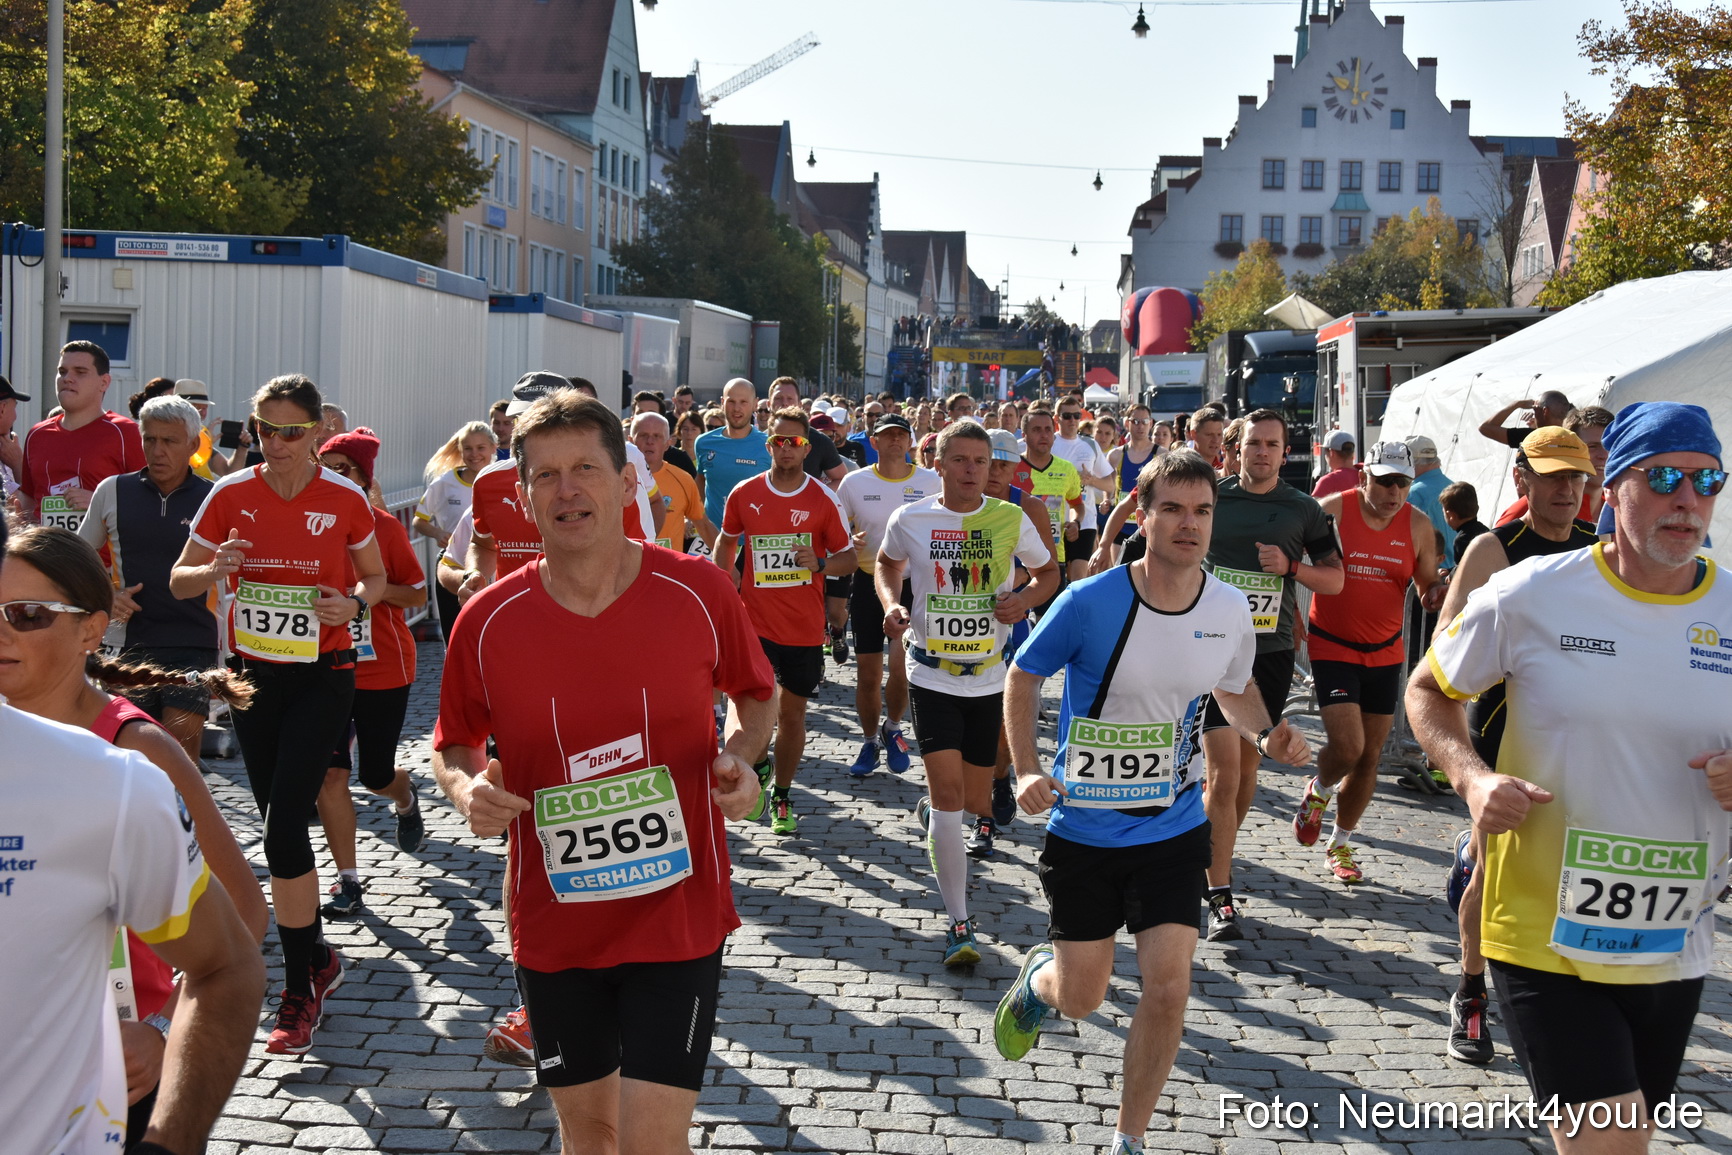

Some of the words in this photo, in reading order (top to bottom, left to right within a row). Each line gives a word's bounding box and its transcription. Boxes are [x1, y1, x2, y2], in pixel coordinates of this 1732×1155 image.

[968, 352, 1006, 362] START
[735, 458, 757, 466] BOCK
[44, 498, 68, 510] BO
[756, 535, 807, 550] BOCK
[934, 530, 966, 540] PITZTAL
[930, 540, 993, 550] GLETSCHER
[760, 553, 802, 570] 124
[930, 549, 993, 560] MARATHON
[764, 573, 801, 582] MARCEL
[1218, 570, 1277, 590] BOCK
[237, 585, 313, 608] BOCK
[932, 596, 995, 612] BOCK
[241, 608, 310, 637] 1378
[934, 616, 991, 638] 1099
[1561, 634, 1616, 652] BOCK
[1690, 628, 1718, 646] 20
[944, 643, 980, 652] FRANZ
[1075, 722, 1166, 746] BOCK
[588, 748, 622, 769] DEHN
[1077, 751, 1160, 779] 2192
[544, 771, 665, 821] BOCK
[1074, 786, 1161, 798] CHRISTOPH
[668, 810, 676, 818] C
[555, 812, 668, 865] 2569
[1576, 835, 1699, 875] BOCK
[569, 859, 672, 889] GERHARD
[1575, 878, 1689, 922] 2817
[115, 981, 124, 990] C
